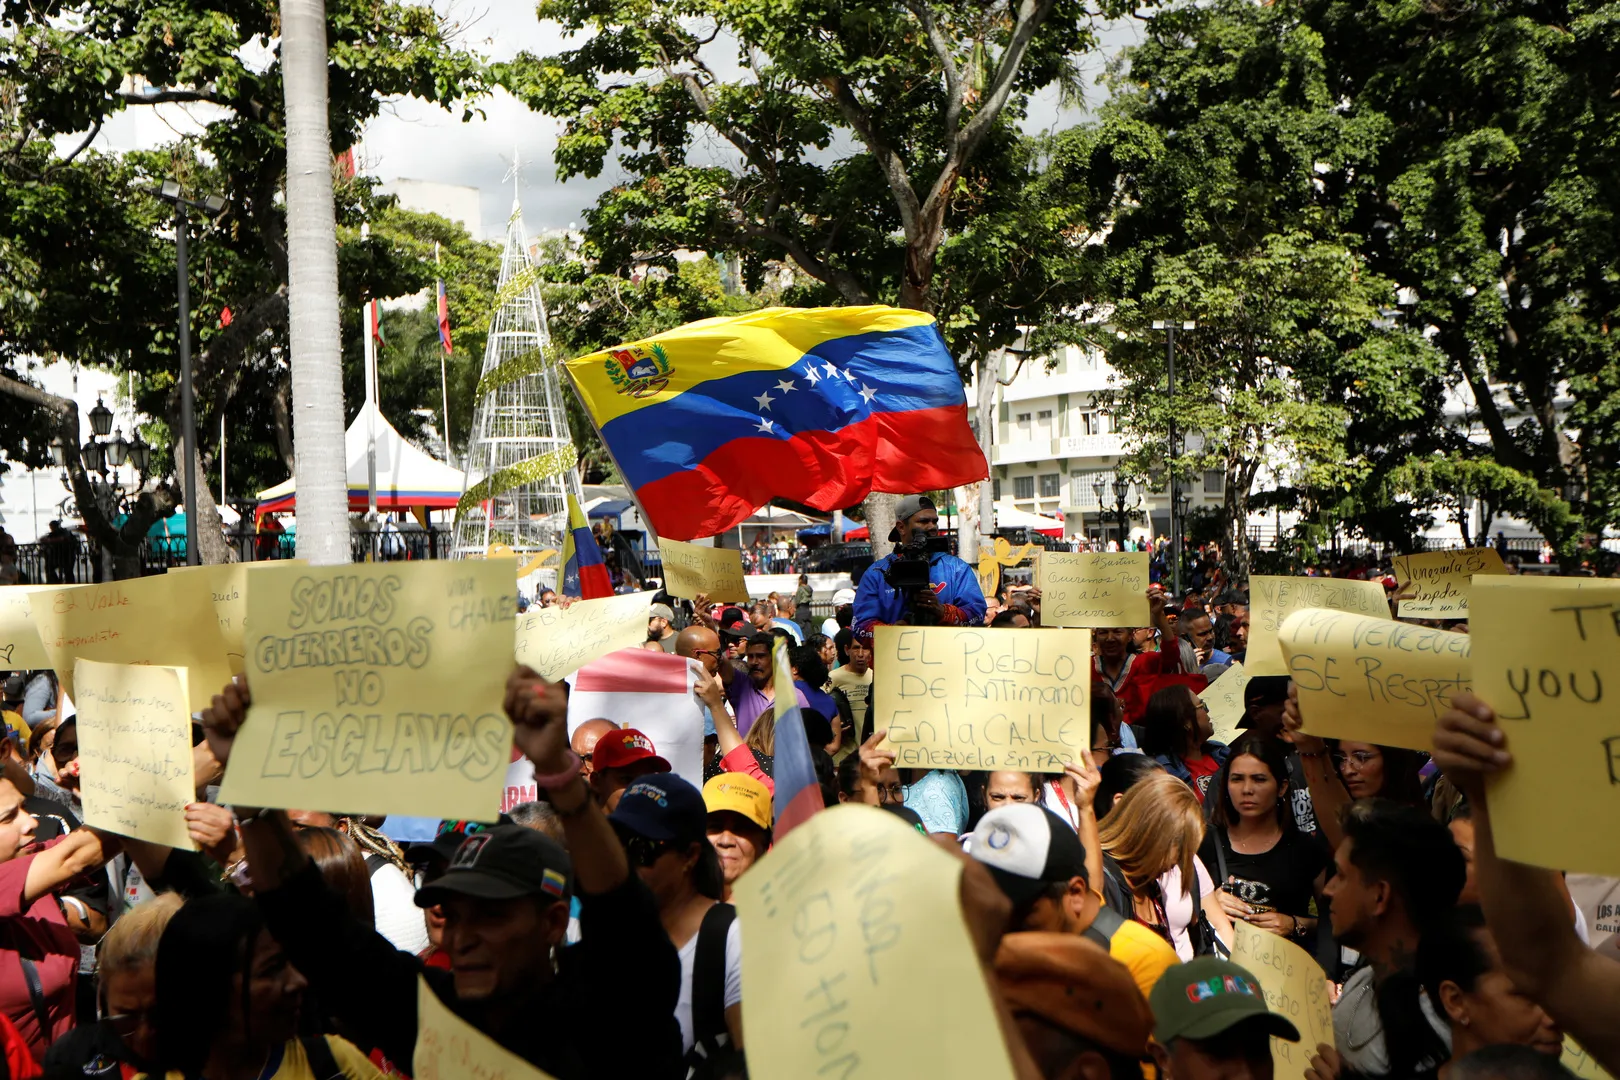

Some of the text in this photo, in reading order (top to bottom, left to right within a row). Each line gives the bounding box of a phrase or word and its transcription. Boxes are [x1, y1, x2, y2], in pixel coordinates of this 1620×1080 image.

[1047, 553, 1079, 565] San
[287, 575, 402, 630] SOMOS
[254, 616, 436, 674] GUERREROS
[896, 630, 943, 665] EL
[334, 668, 386, 708] NO
[897, 673, 948, 700] DE
[260, 710, 509, 782] ESCLAVOS
